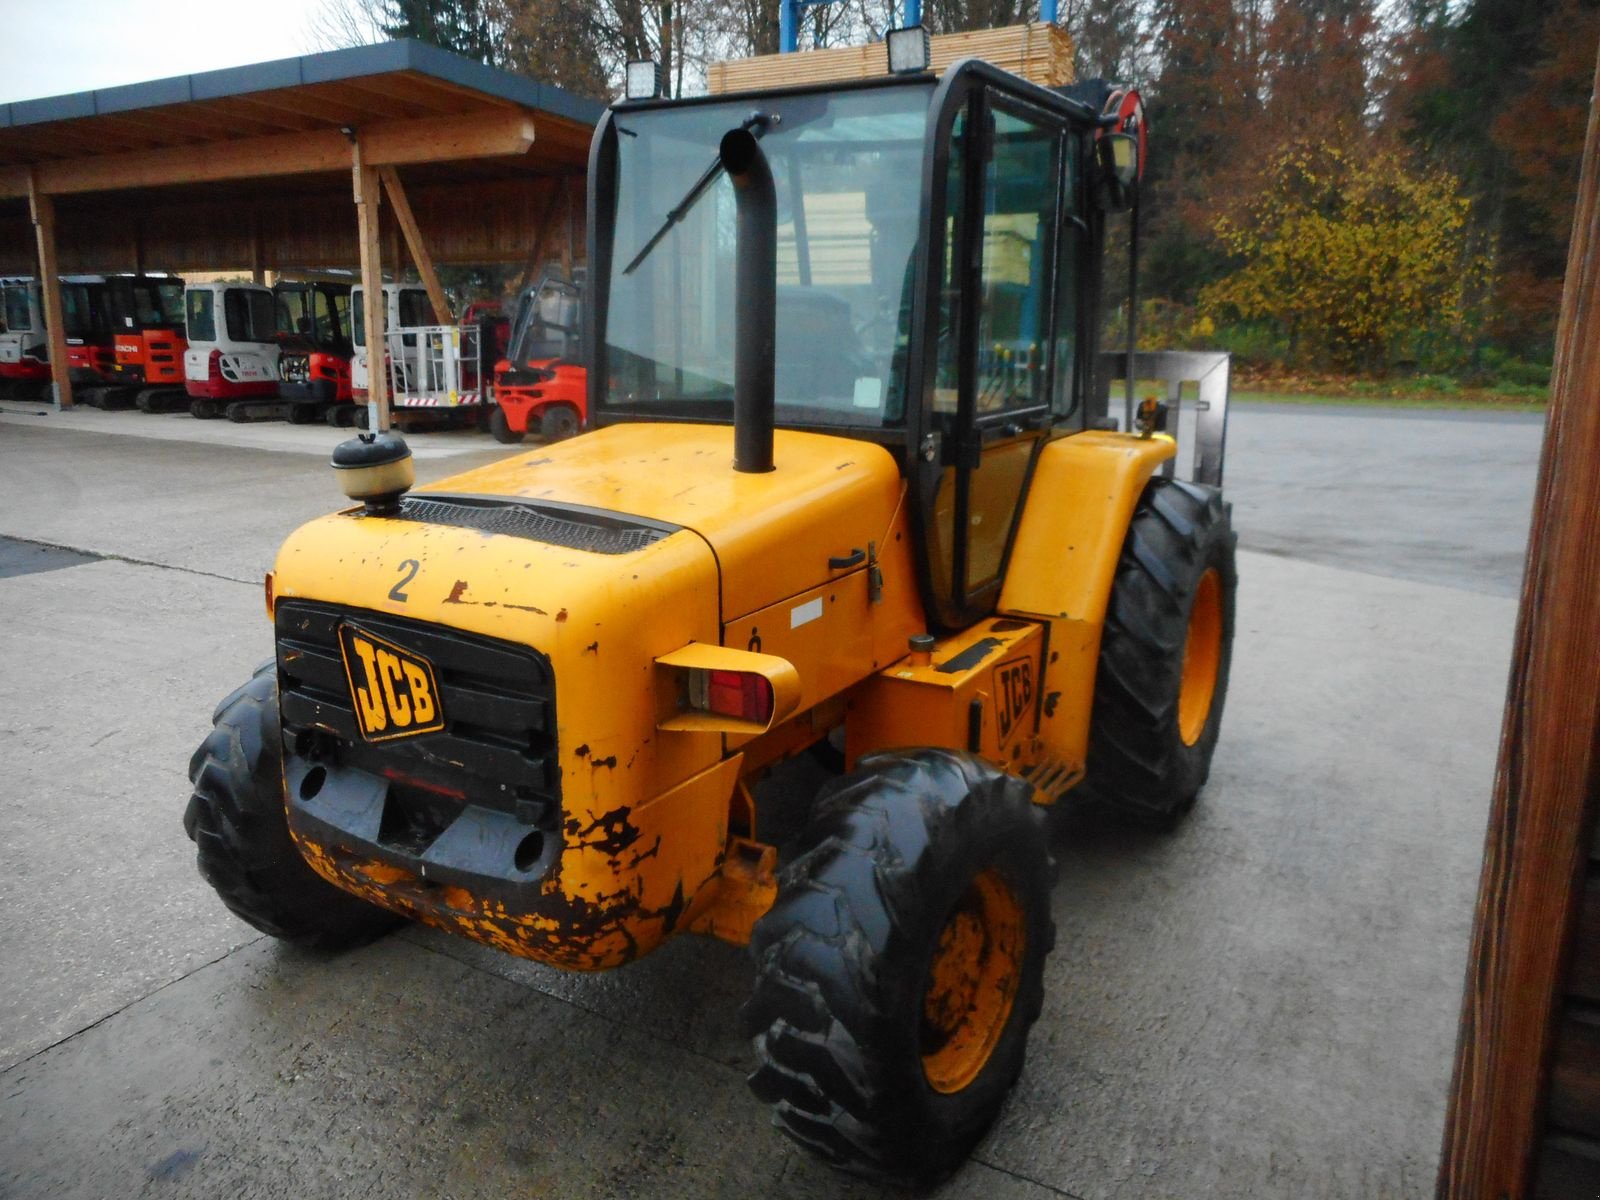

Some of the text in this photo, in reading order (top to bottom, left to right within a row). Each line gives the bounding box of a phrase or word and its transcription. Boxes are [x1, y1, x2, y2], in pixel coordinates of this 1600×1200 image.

[388, 559, 420, 603] 2
[353, 637, 435, 732] JCB
[1001, 663, 1031, 737] JCB
